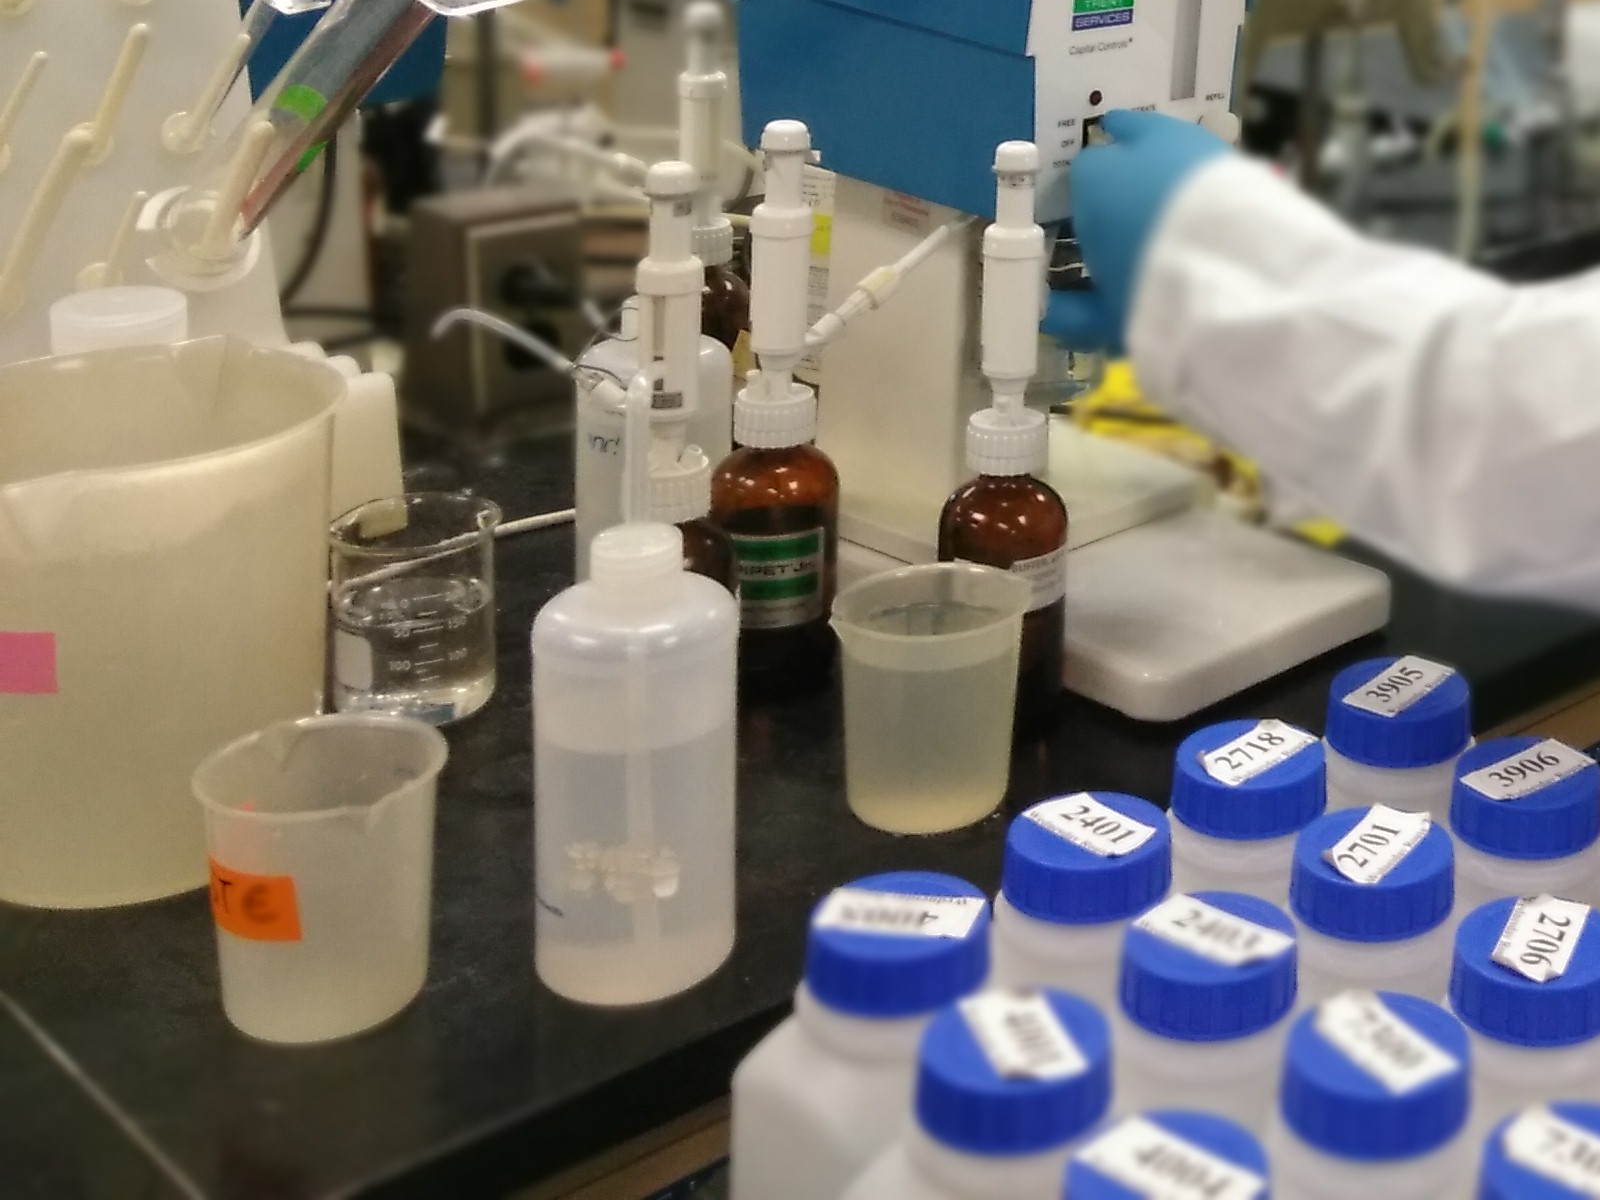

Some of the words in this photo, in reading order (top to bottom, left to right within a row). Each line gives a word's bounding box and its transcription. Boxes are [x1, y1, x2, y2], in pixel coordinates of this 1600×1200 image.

[1075, 11, 1130, 28] SERVICES
[1205, 93, 1224, 101] REFILL
[1057, 118, 1076, 128] FREE
[1060, 138, 1075, 148] OFF
[390, 660, 411, 671] 100
[1366, 666, 1423, 703] 3905
[1214, 731, 1285, 770] 2718
[1488, 750, 1560, 788] 3906
[1060, 804, 1136, 844] 2401
[1337, 823, 1401, 868] 2701
[1519, 912, 1571, 966] 2706
